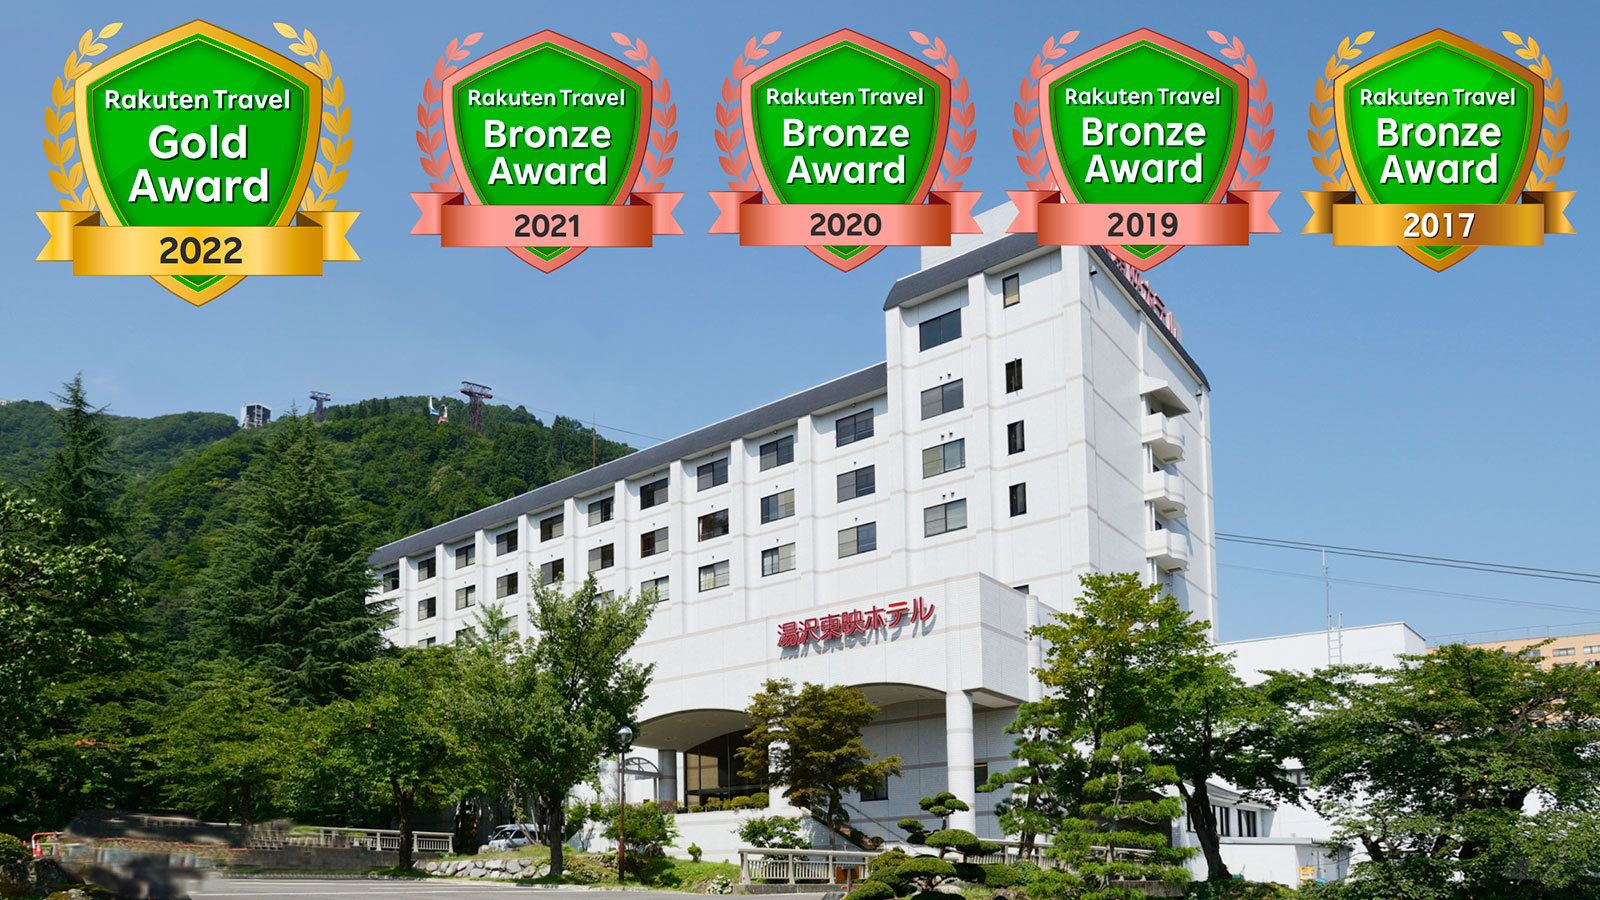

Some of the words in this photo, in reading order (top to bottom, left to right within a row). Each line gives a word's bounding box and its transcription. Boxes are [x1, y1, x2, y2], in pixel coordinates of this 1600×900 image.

[777, 596, 935, 647] 湯沢東映ホテル
